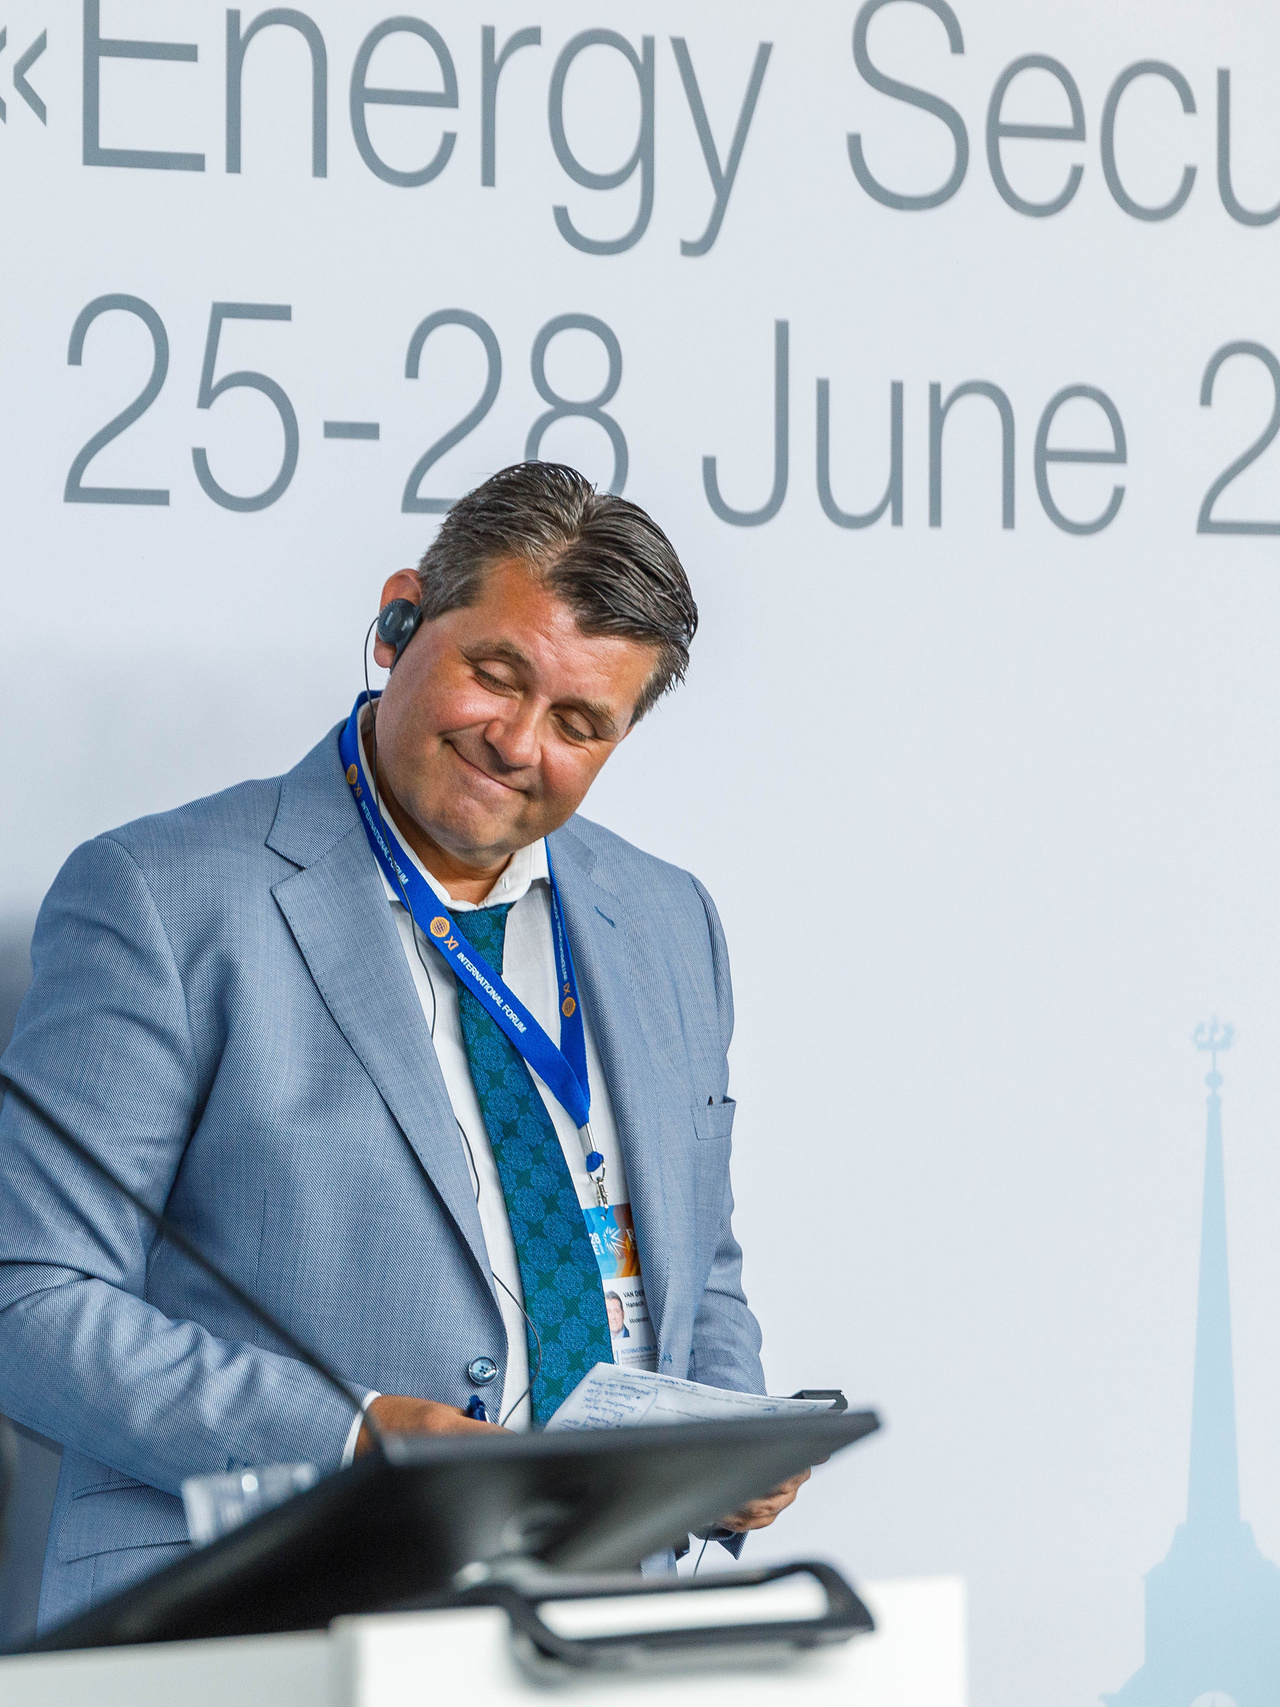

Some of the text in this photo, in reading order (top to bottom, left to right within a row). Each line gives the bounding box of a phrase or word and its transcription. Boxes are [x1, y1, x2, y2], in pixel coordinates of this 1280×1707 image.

[63, 293, 630, 514] 25-28
[702, 319, 1128, 536] June
[360, 800, 390, 859] INTERNATIONAL
[443, 935, 528, 1035] XI INTERNATIONAL FORUM
